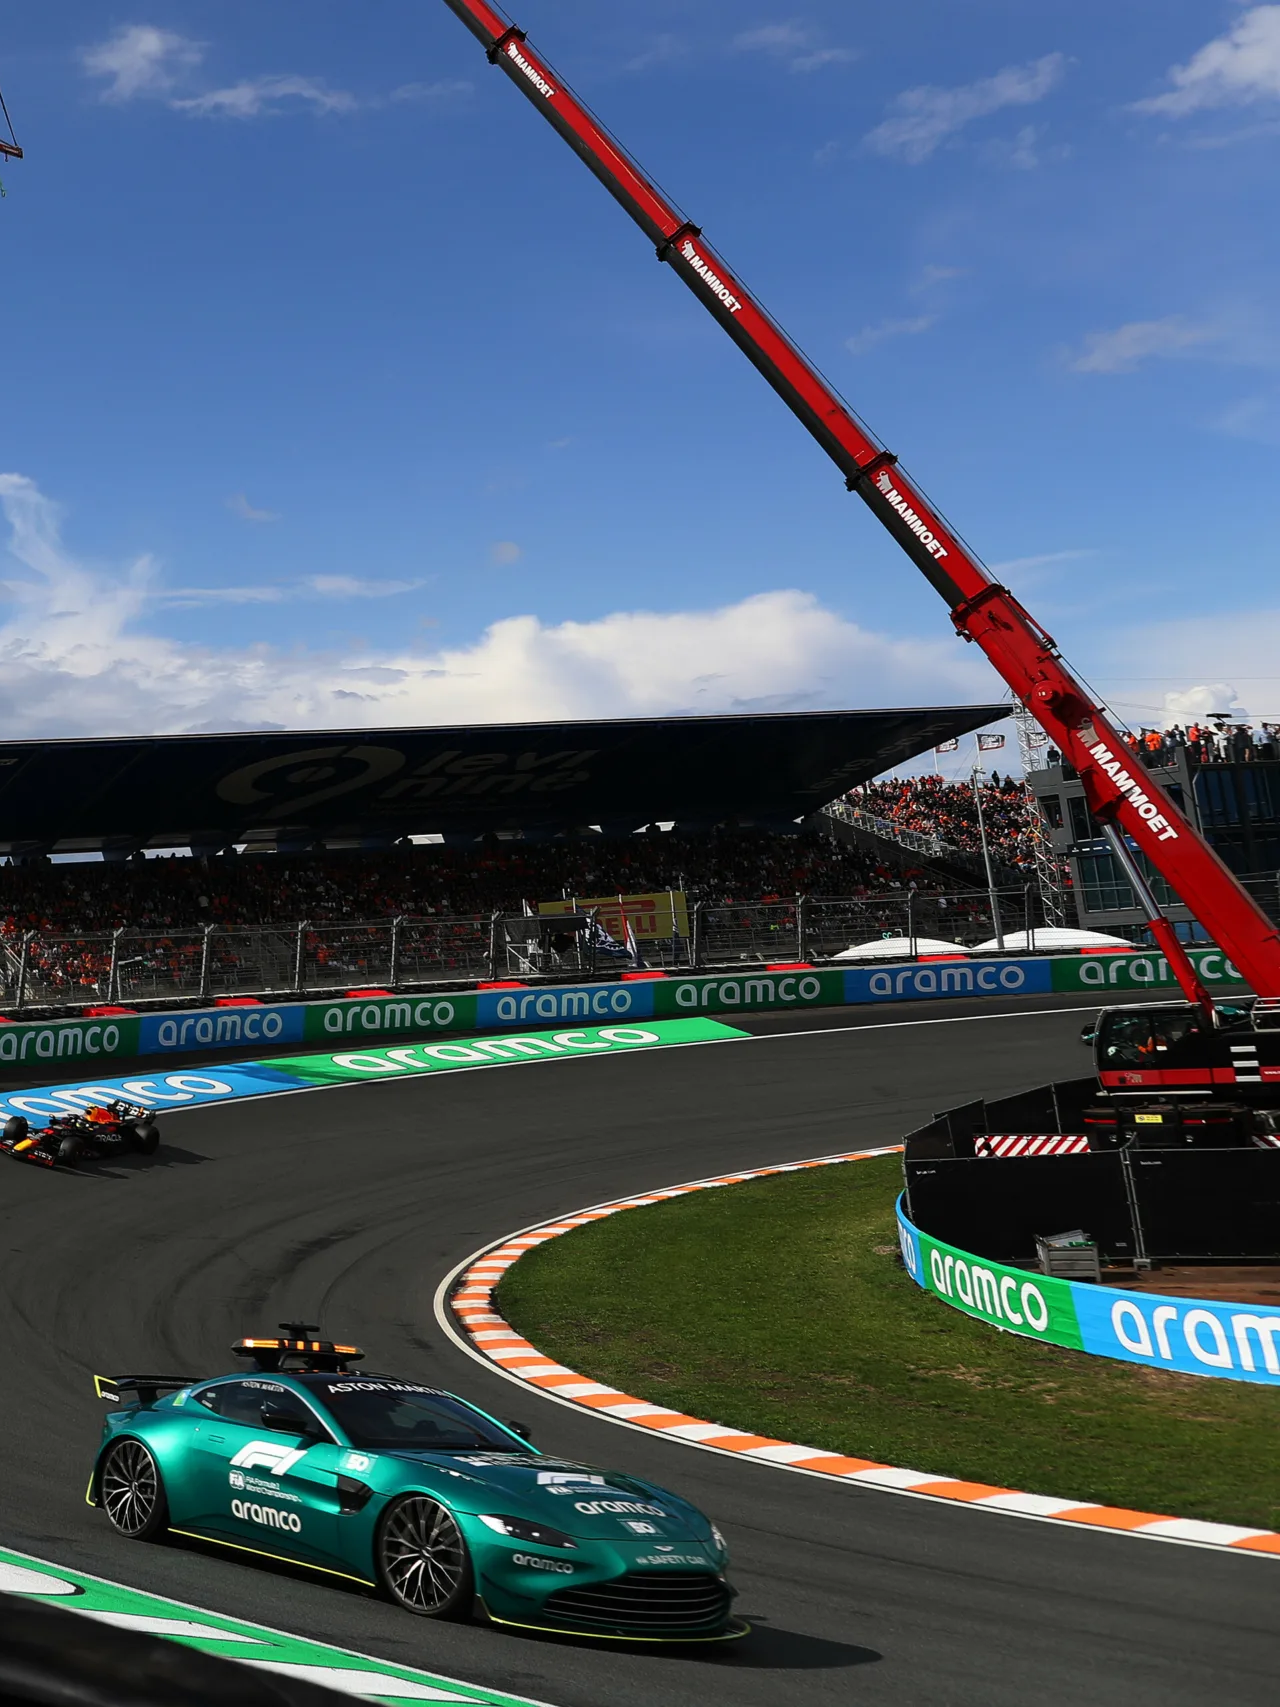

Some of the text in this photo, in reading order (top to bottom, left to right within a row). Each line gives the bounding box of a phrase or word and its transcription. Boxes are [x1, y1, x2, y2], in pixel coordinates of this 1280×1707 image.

[514, 54, 555, 98] MAMMOET
[691, 256, 742, 313] MAMMOET
[886, 489, 948, 561] MAMMOET
[1090, 743, 1179, 842] MAMMOET
[675, 975, 821, 1007] aramco
[869, 966, 1025, 995] aramco
[323, 1000, 455, 1033] aramco
[496, 988, 632, 1020] aramco
[158, 1006, 283, 1047] aramco
[331, 1027, 660, 1073] aramco
[930, 1247, 1050, 1333] aramco
[328, 1382, 453, 1398] ASTON MARTIN
[229, 1440, 308, 1477] F1
[231, 1498, 302, 1533] aramco
[574, 1500, 667, 1517] aramco
[513, 1553, 575, 1575] aramco
[648, 1555, 686, 1565] SAFETY
[686, 1555, 708, 1565] CAR
